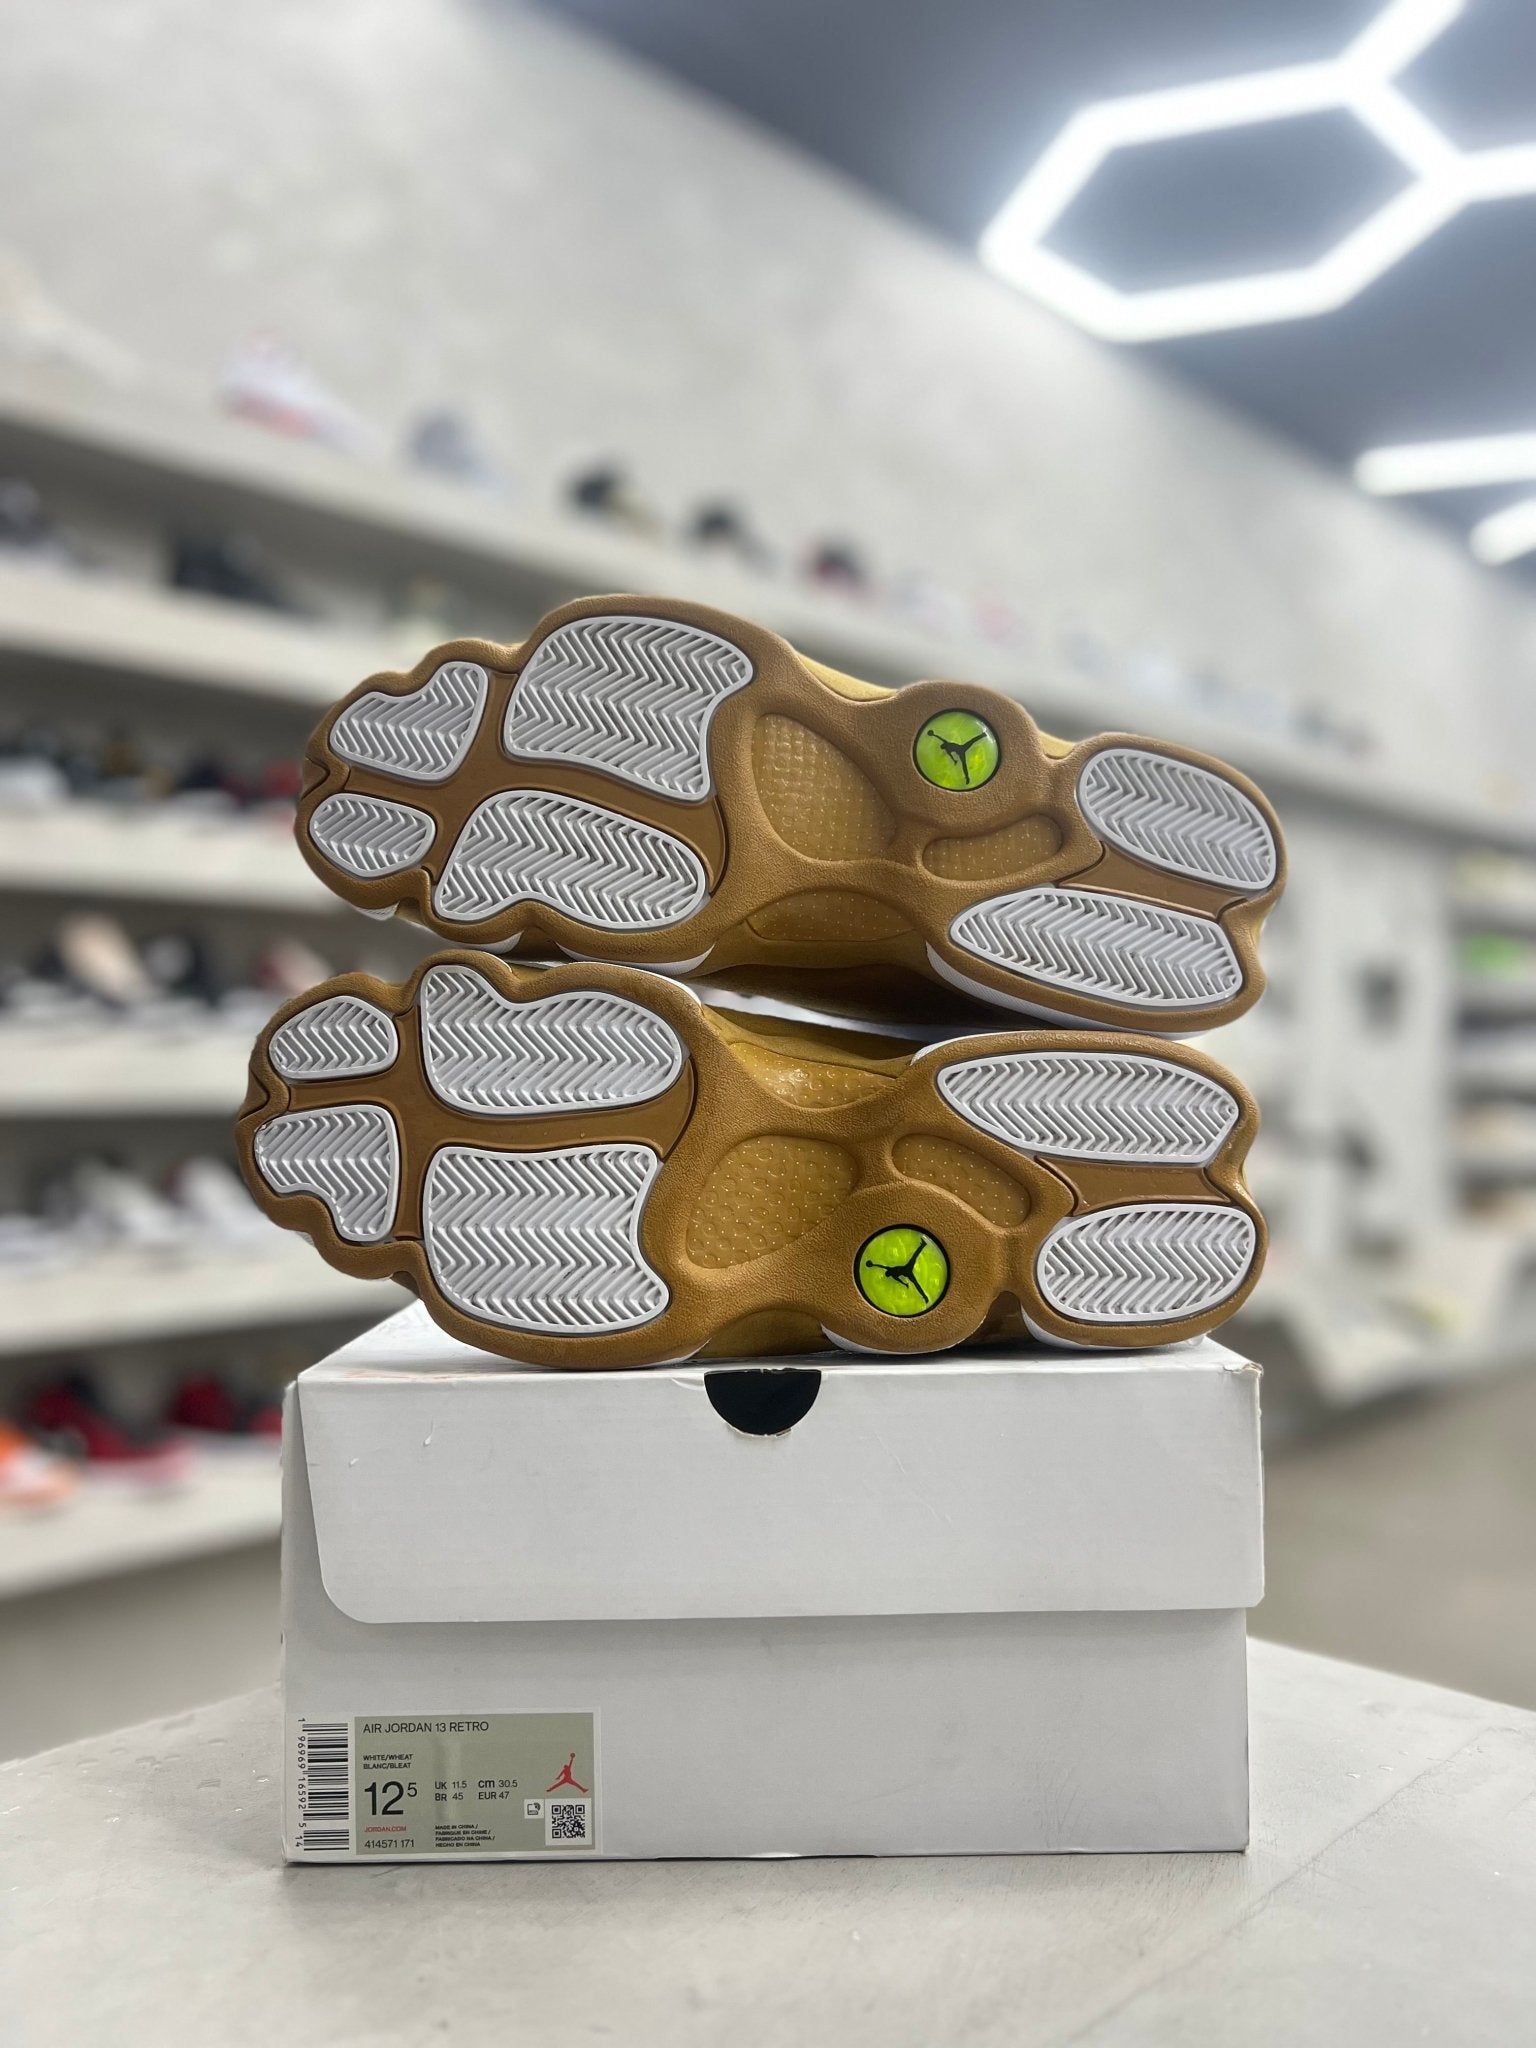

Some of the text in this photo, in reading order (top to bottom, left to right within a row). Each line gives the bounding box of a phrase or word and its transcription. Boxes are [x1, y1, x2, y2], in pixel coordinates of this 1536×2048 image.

[363, 1721, 489, 1734] AIR JORDAN 13 RETRO
[297, 1735, 306, 1769] 96969
[434, 1779, 518, 1790] UK 11.5 cm 30.5
[297, 1776, 307, 1810] 16592
[434, 1791, 510, 1801] BR 45 EUR 47
[364, 1839, 415, 1849] 414571 171
